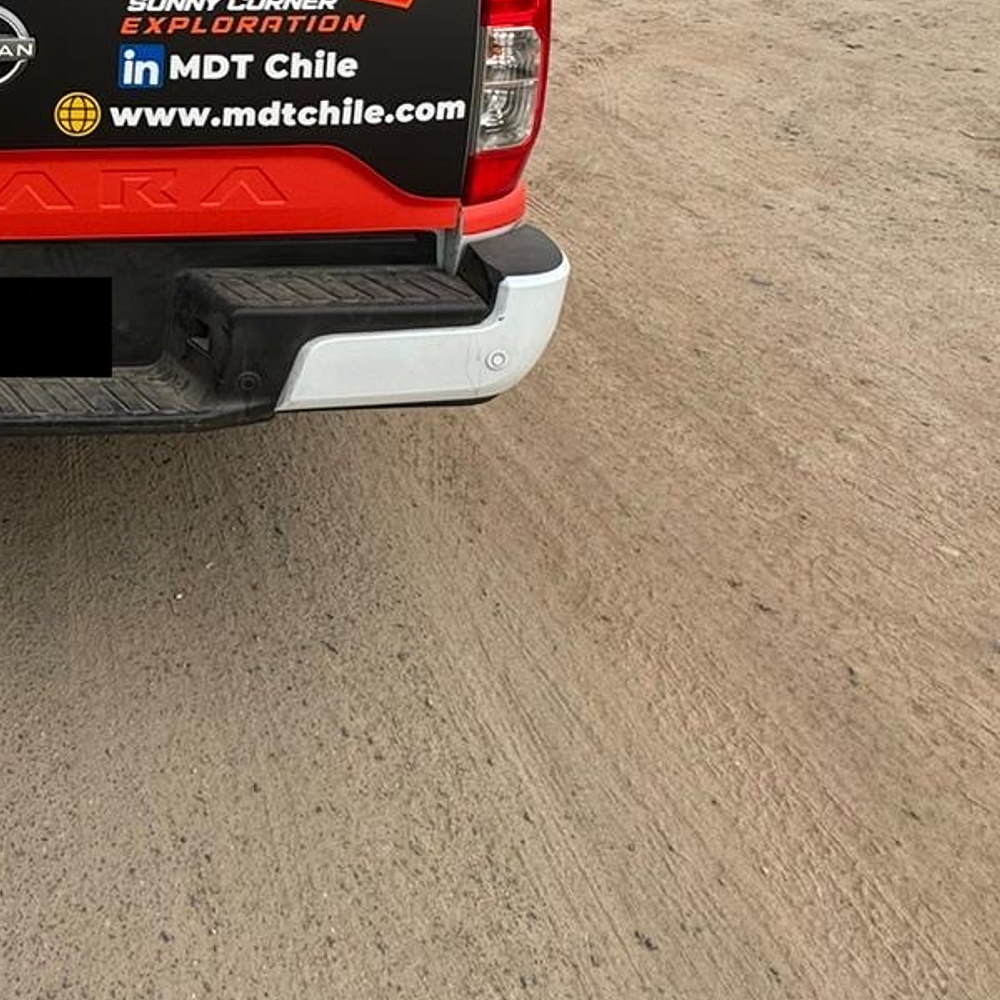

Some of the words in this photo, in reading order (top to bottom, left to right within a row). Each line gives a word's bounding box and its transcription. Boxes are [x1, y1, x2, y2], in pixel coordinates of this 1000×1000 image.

[121, 15, 366, 35] EXPLORATION
[170, 53, 254, 80] MDT
[265, 50, 358, 79] Chile
[111, 98, 466, 128] www.mdtchile.com
